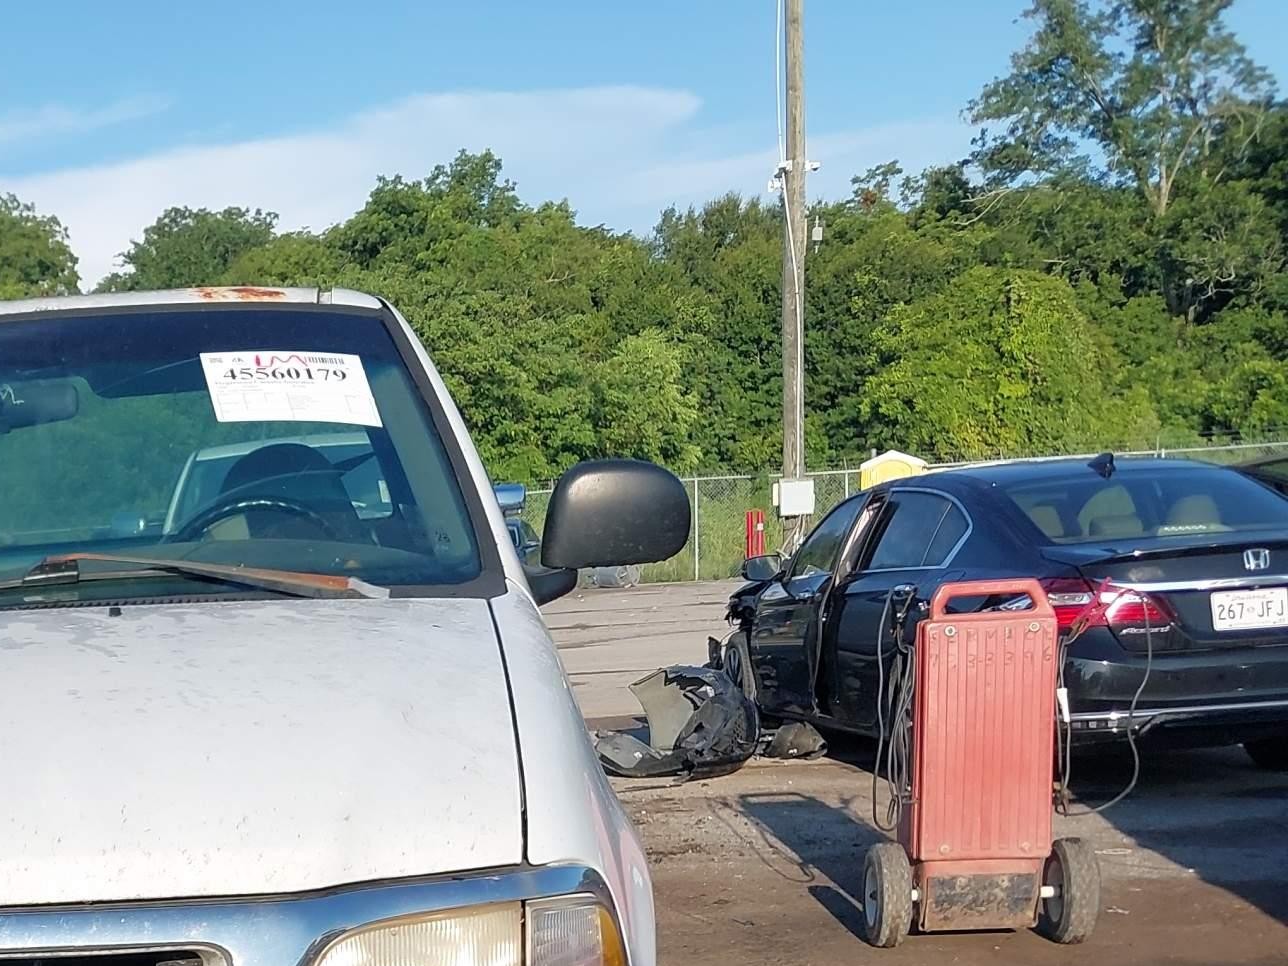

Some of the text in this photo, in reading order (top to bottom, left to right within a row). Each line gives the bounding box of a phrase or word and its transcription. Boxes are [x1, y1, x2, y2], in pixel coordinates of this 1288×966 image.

[223, 368, 348, 381] 45560179
[1217, 599, 1284, 621] 267 JFJ
